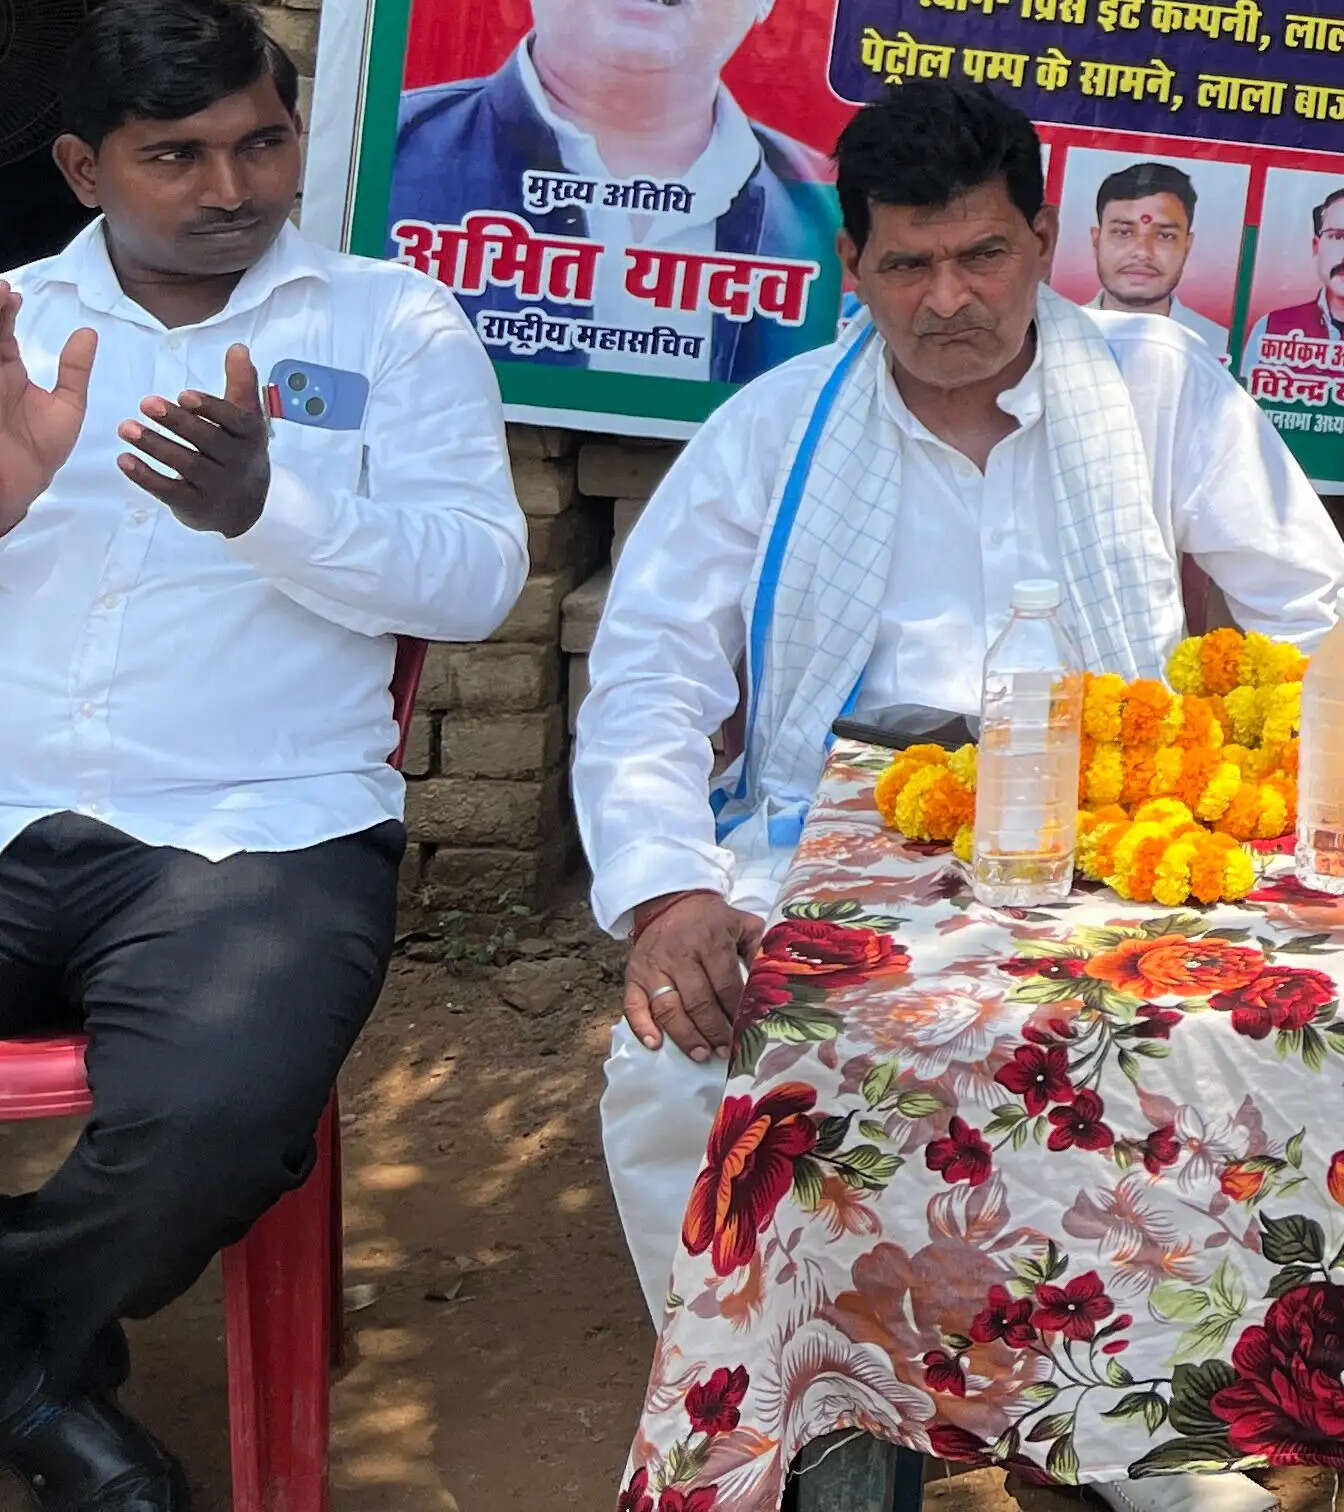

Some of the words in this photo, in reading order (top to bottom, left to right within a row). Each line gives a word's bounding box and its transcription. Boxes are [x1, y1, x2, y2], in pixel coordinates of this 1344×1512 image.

[861, 28, 955, 85] पेट्रोल
[962, 48, 1030, 87] पम्प
[1036, 47, 1072, 91] के
[1079, 58, 1184, 108] सामने,
[1197, 74, 1288, 115] लाला
[527, 175, 598, 208] मुख्य
[602, 180, 697, 215] अतिथि
[395, 215, 606, 301] अमित
[624, 246, 815, 321] यादव
[481, 312, 569, 349] राष्ट्रीय
[576, 324, 705, 359] महासचिव
